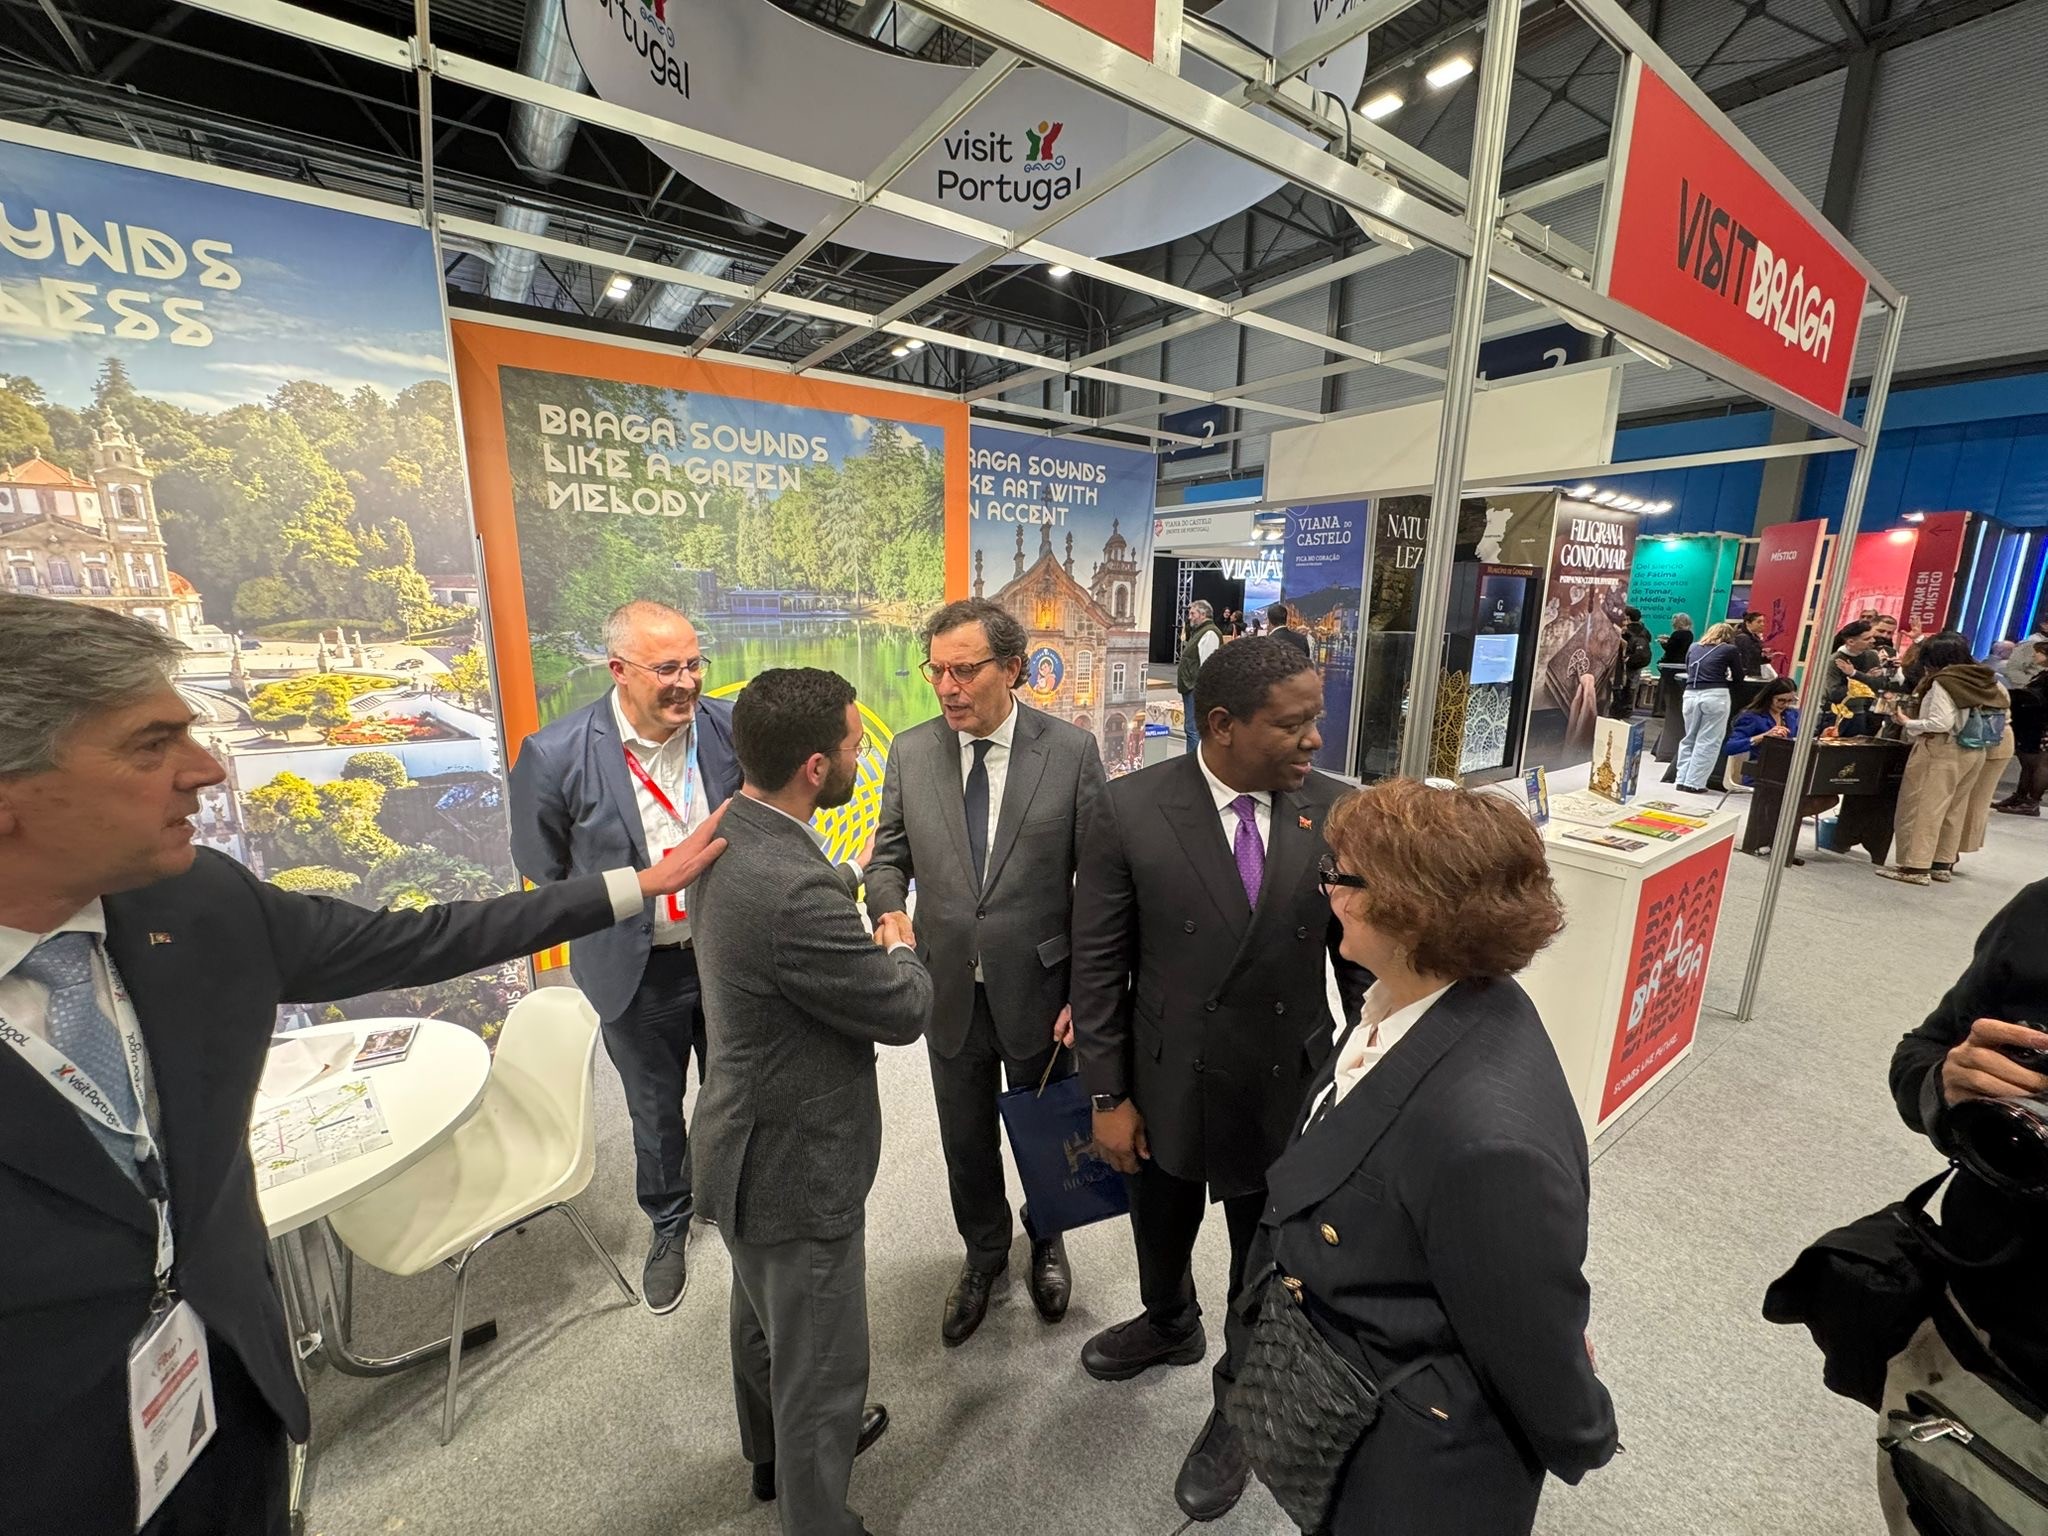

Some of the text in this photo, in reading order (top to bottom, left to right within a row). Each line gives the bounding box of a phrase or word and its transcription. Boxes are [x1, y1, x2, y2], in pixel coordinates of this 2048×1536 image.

[944, 129, 1013, 163] visit
[938, 167, 1081, 211] Portugal
[539, 403, 829, 462] BRAGA SOUNDS
[543, 443, 801, 492] LIKE A GREEN
[1028, 456, 1107, 484] SOUNDS
[547, 480, 712, 518] MELODY
[1002, 477, 1042, 500] ART
[1050, 482, 1098, 506] WITH
[987, 501, 1070, 526] ACCENT
[1298, 515, 1340, 531] VIANA
[1296, 530, 1351, 546] CASTELO
[1570, 518, 1624, 546] FILIGRANA
[1220, 549, 1285, 585] VIAJA
[1560, 543, 1627, 570] GONDOMAR
[1916, 571, 1930, 585] EN
[68, 1075, 91, 1096] visit
